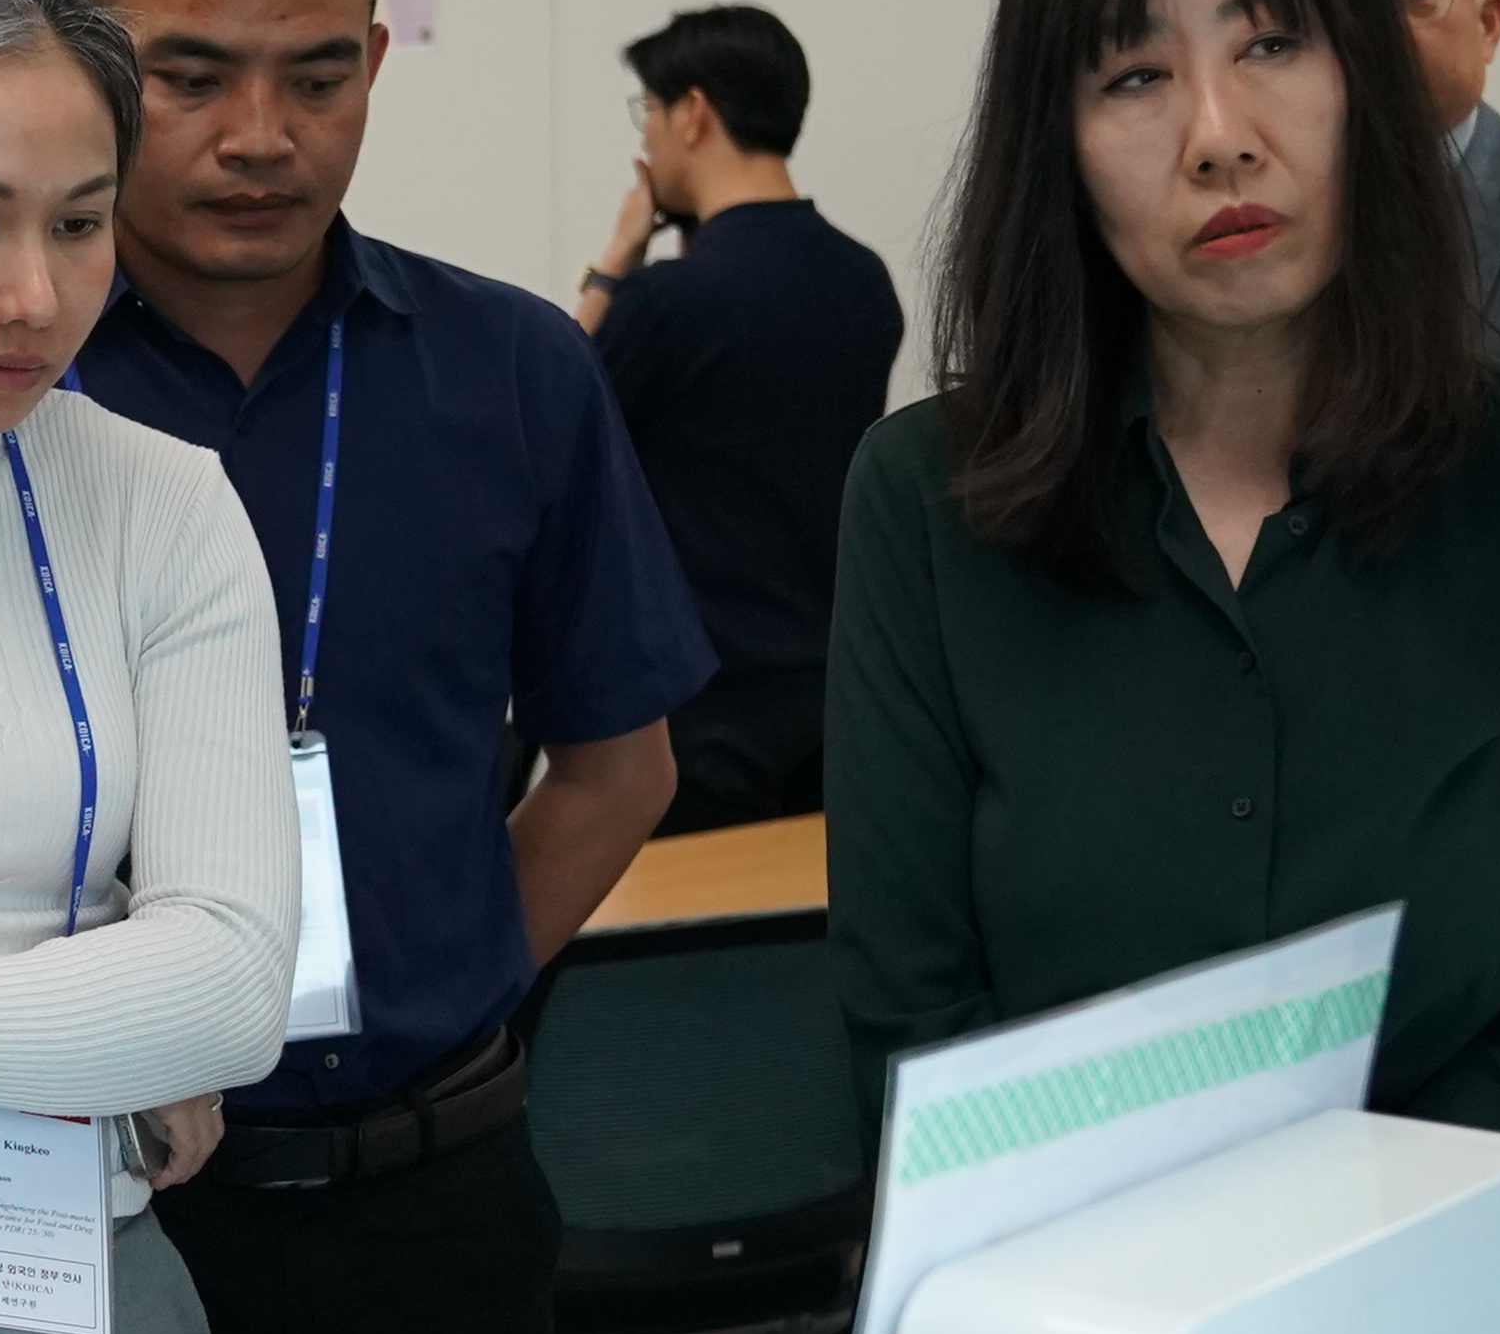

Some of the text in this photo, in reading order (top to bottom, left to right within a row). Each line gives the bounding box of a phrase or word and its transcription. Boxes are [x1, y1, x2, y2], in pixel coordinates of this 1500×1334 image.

[21, 490, 35, 518] KOICA
[39, 565, 54, 593] KOICA
[58, 642, 73, 671] KOICA
[77, 721, 92, 753] KOICA
[83, 806, 93, 836] KOICA
[4, 1140, 50, 1156] Kingkeo
[37, 1218, 57, 1229] Food
[58, 1222, 73, 1232] and
[74, 1224, 94, 1235] Drug
[38, 1207, 50, 1216] the
[51, 1209, 96, 1224] Post-market
[7, 1263, 36, 1278] 외국인
[40, 1269, 59, 1281] 정부
[62, 1272, 82, 1285] 인사
